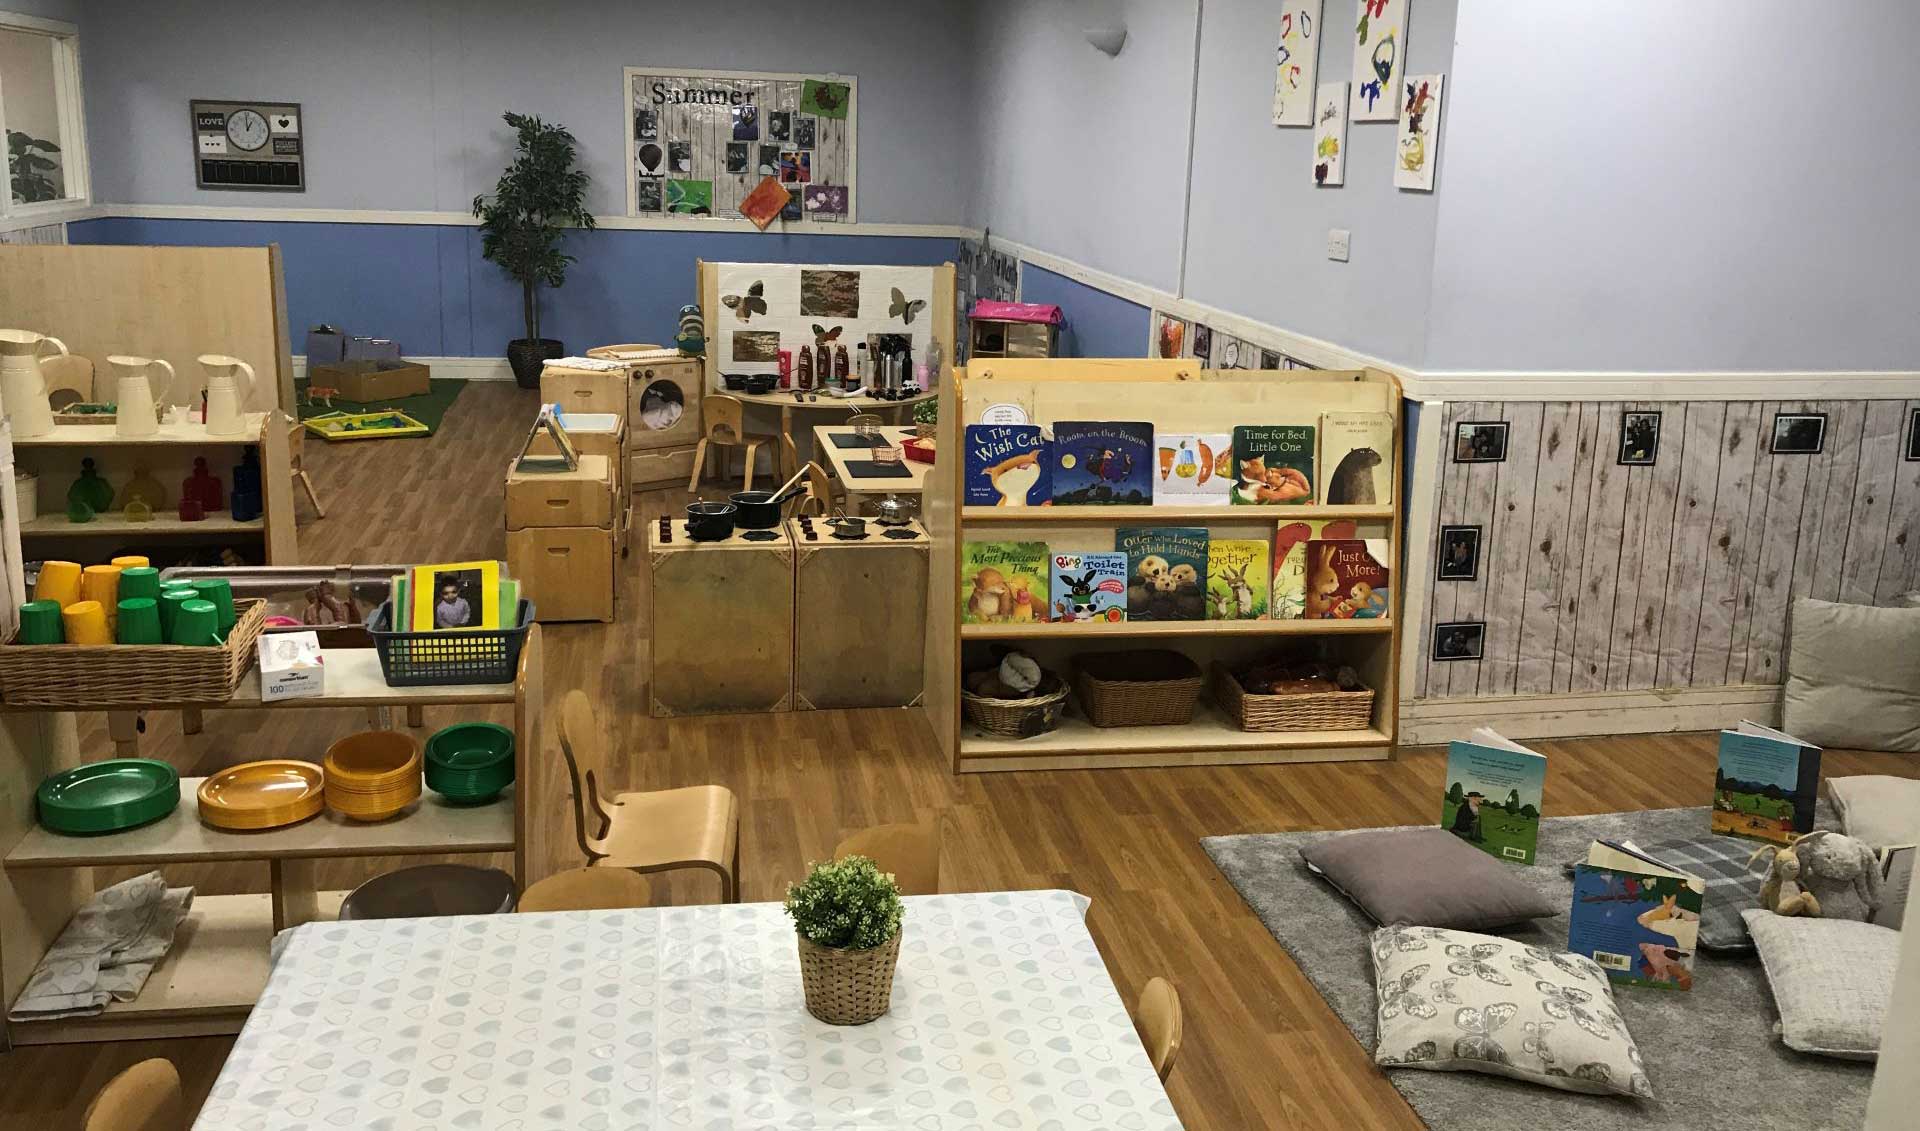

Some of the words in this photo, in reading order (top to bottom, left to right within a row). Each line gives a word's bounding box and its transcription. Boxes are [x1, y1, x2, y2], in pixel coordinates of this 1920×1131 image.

[652, 82, 755, 105] Summer
[989, 427, 1012, 440] The
[1058, 433, 1085, 445] Room
[1101, 429, 1116, 438] the
[1119, 430, 1148, 447] Broom
[1244, 430, 1269, 440] Time
[1271, 430, 1285, 440] for
[975, 442, 1014, 462] Wish
[1016, 433, 1045, 448] Cat
[1250, 442, 1277, 452] Little
[1280, 443, 1302, 452] One
[1124, 536, 1152, 547] Otter
[1174, 534, 1206, 550] Loved
[970, 553, 998, 564] Most
[1000, 552, 1041, 564] Precious
[1130, 549, 1140, 557] to
[1141, 544, 1165, 554] Hold
[1169, 544, 1200, 559] Hands
[1338, 550, 1359, 565] Just
[1012, 563, 1040, 575] Thing
[1056, 556, 1081, 569] Bing
[1084, 560, 1125, 570] Toilet
[1346, 564, 1380, 578] More!
[270, 686, 284, 694] 100
